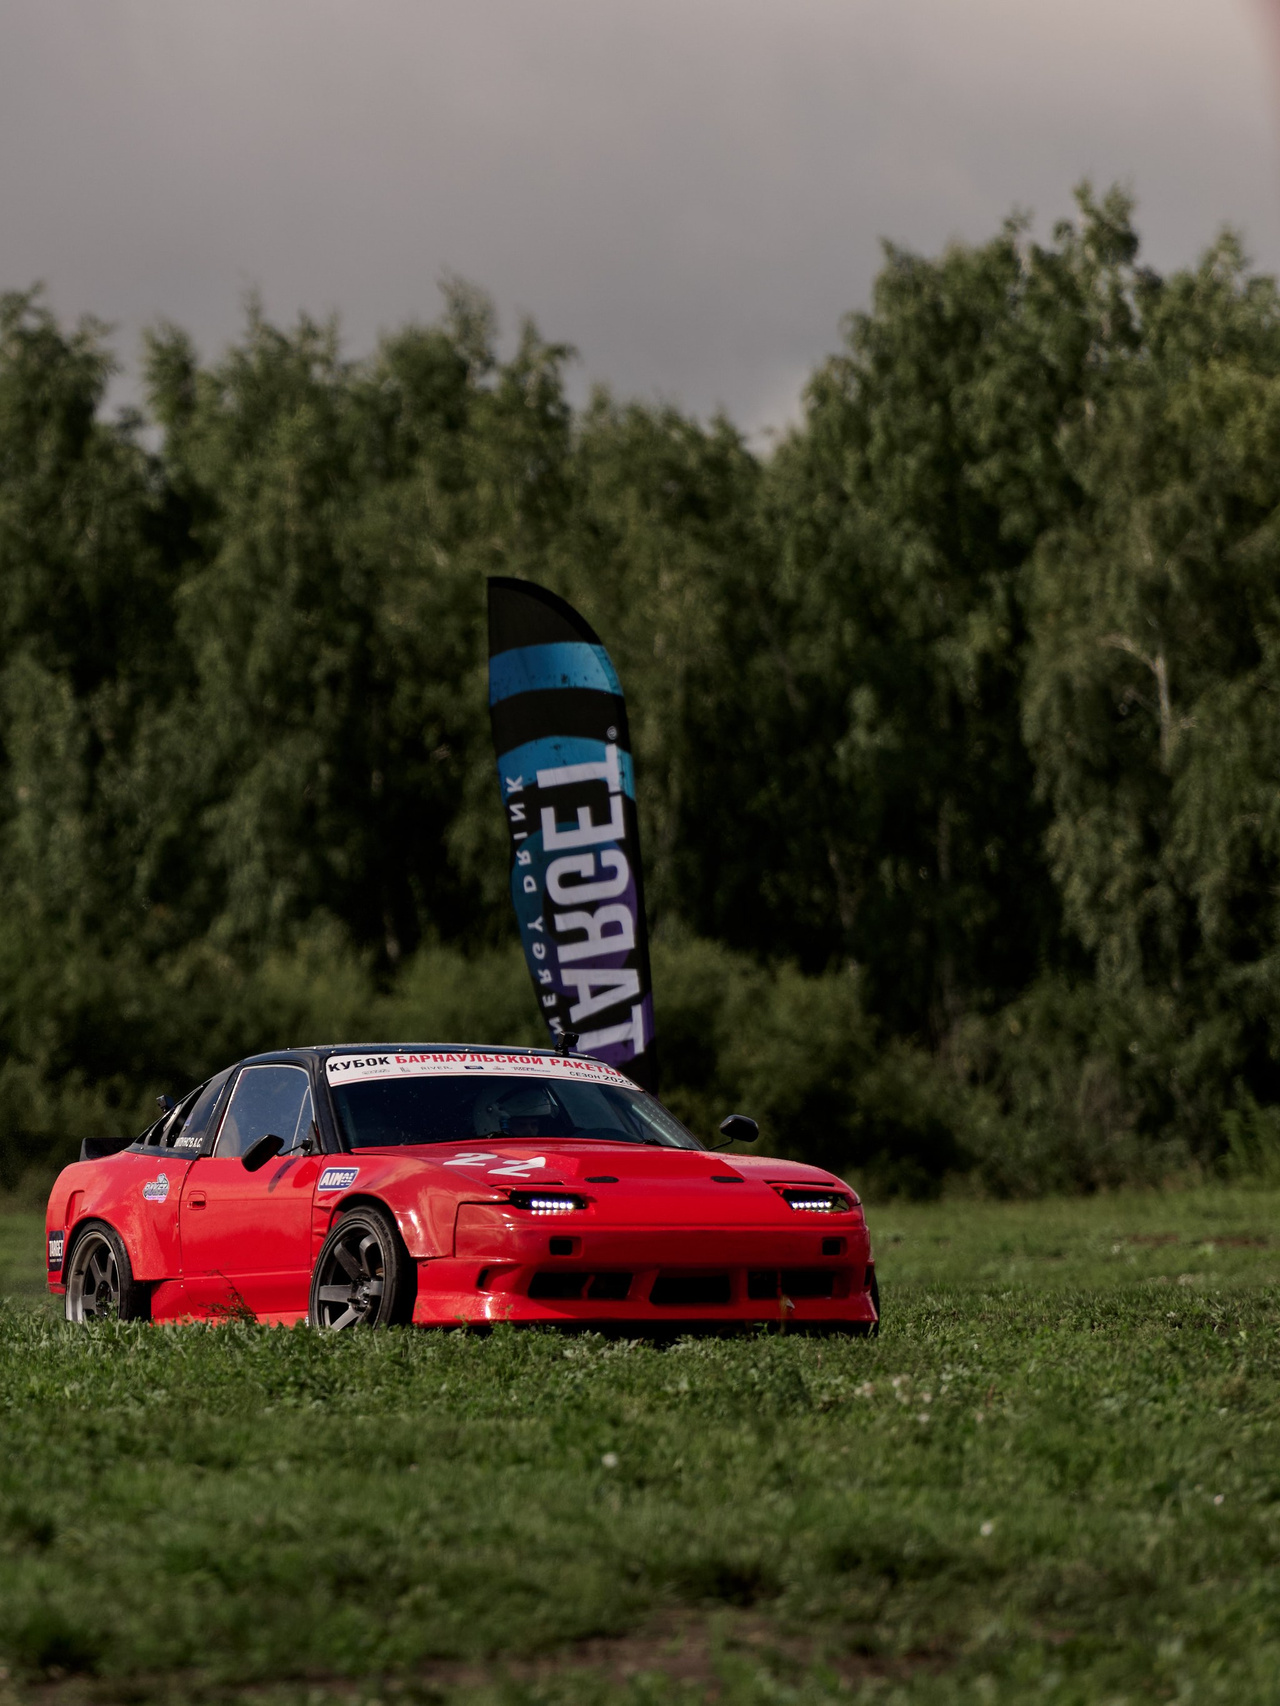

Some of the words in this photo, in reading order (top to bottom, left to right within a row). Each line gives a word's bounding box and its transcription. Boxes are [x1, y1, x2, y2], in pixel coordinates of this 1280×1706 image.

[328, 1056, 390, 1072] КУБОК
[395, 1053, 544, 1065] БАРНАУЛЬСКОЙ
[549, 1057, 622, 1078] РАКЕТЫ
[569, 1071, 600, 1079] СЕЗОН
[602, 1074, 633, 1086] 2025
